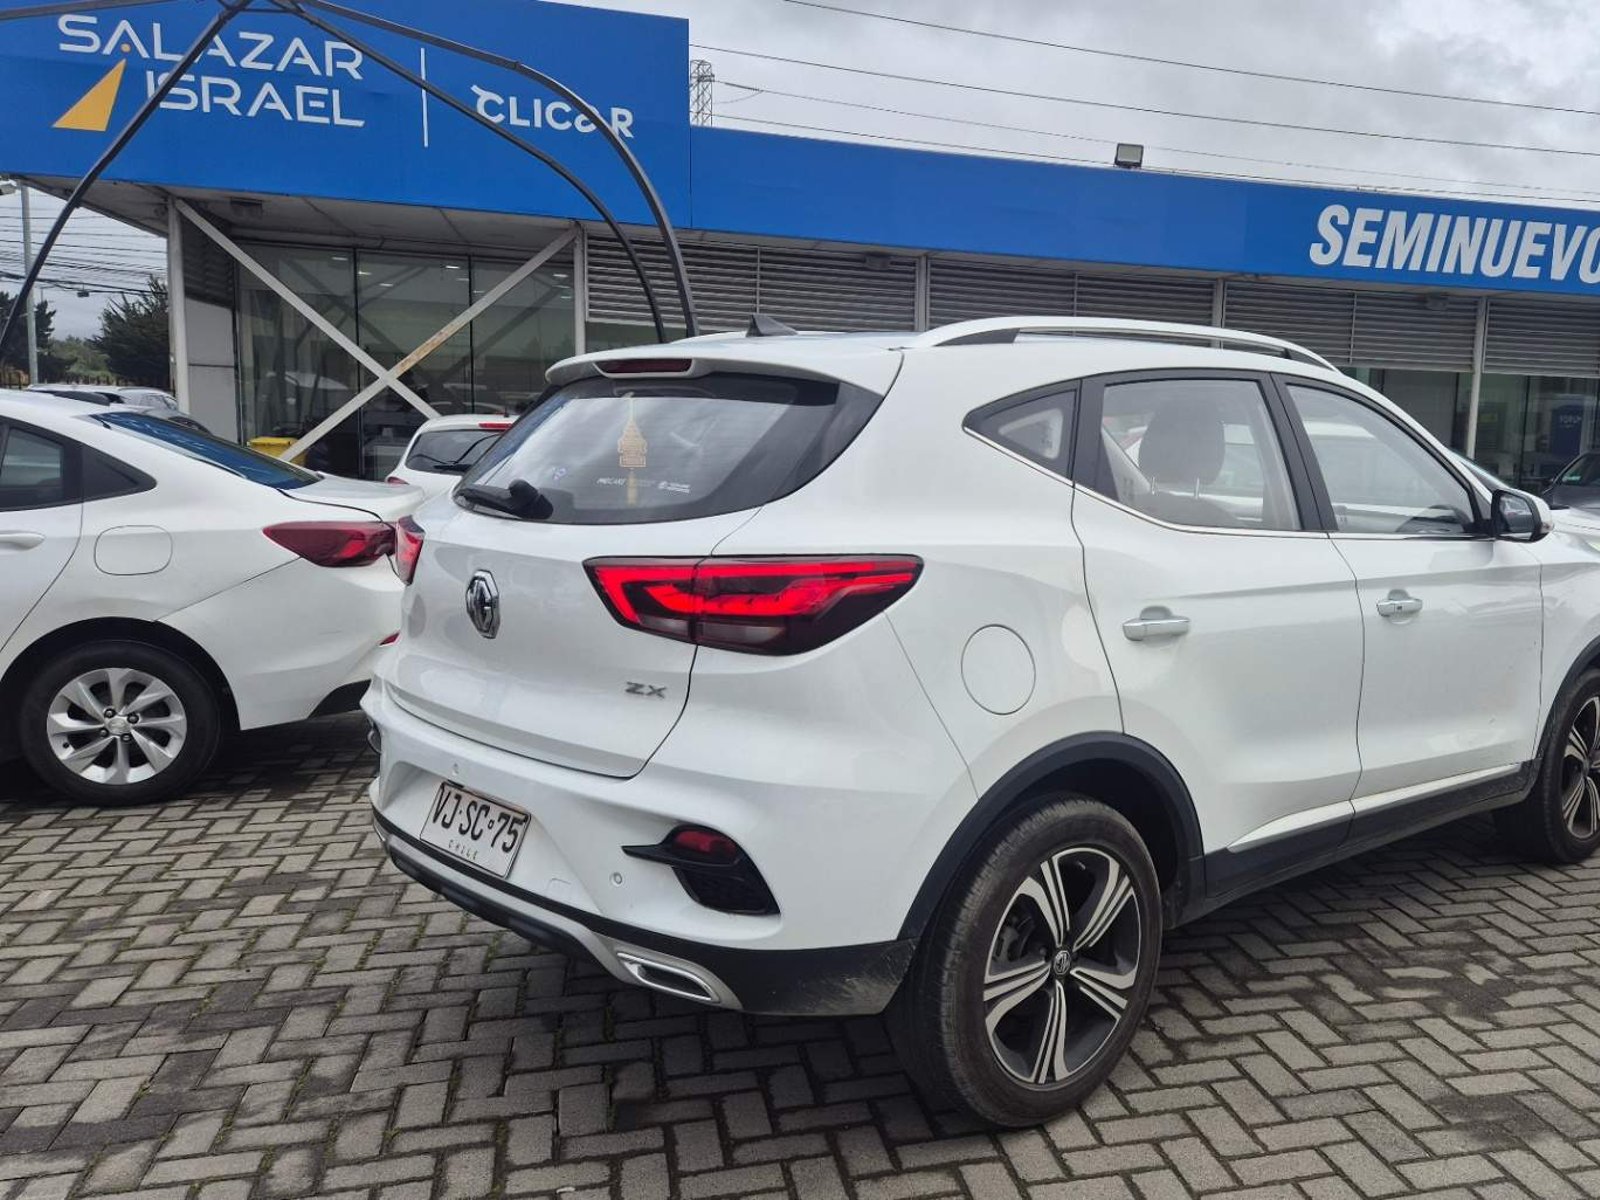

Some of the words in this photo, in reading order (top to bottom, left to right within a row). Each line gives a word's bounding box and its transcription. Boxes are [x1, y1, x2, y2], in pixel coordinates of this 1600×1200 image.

[58, 14, 363, 80] SALAZAR
[147, 70, 365, 127] ISRAEL
[625, 681, 667, 699] ZX
